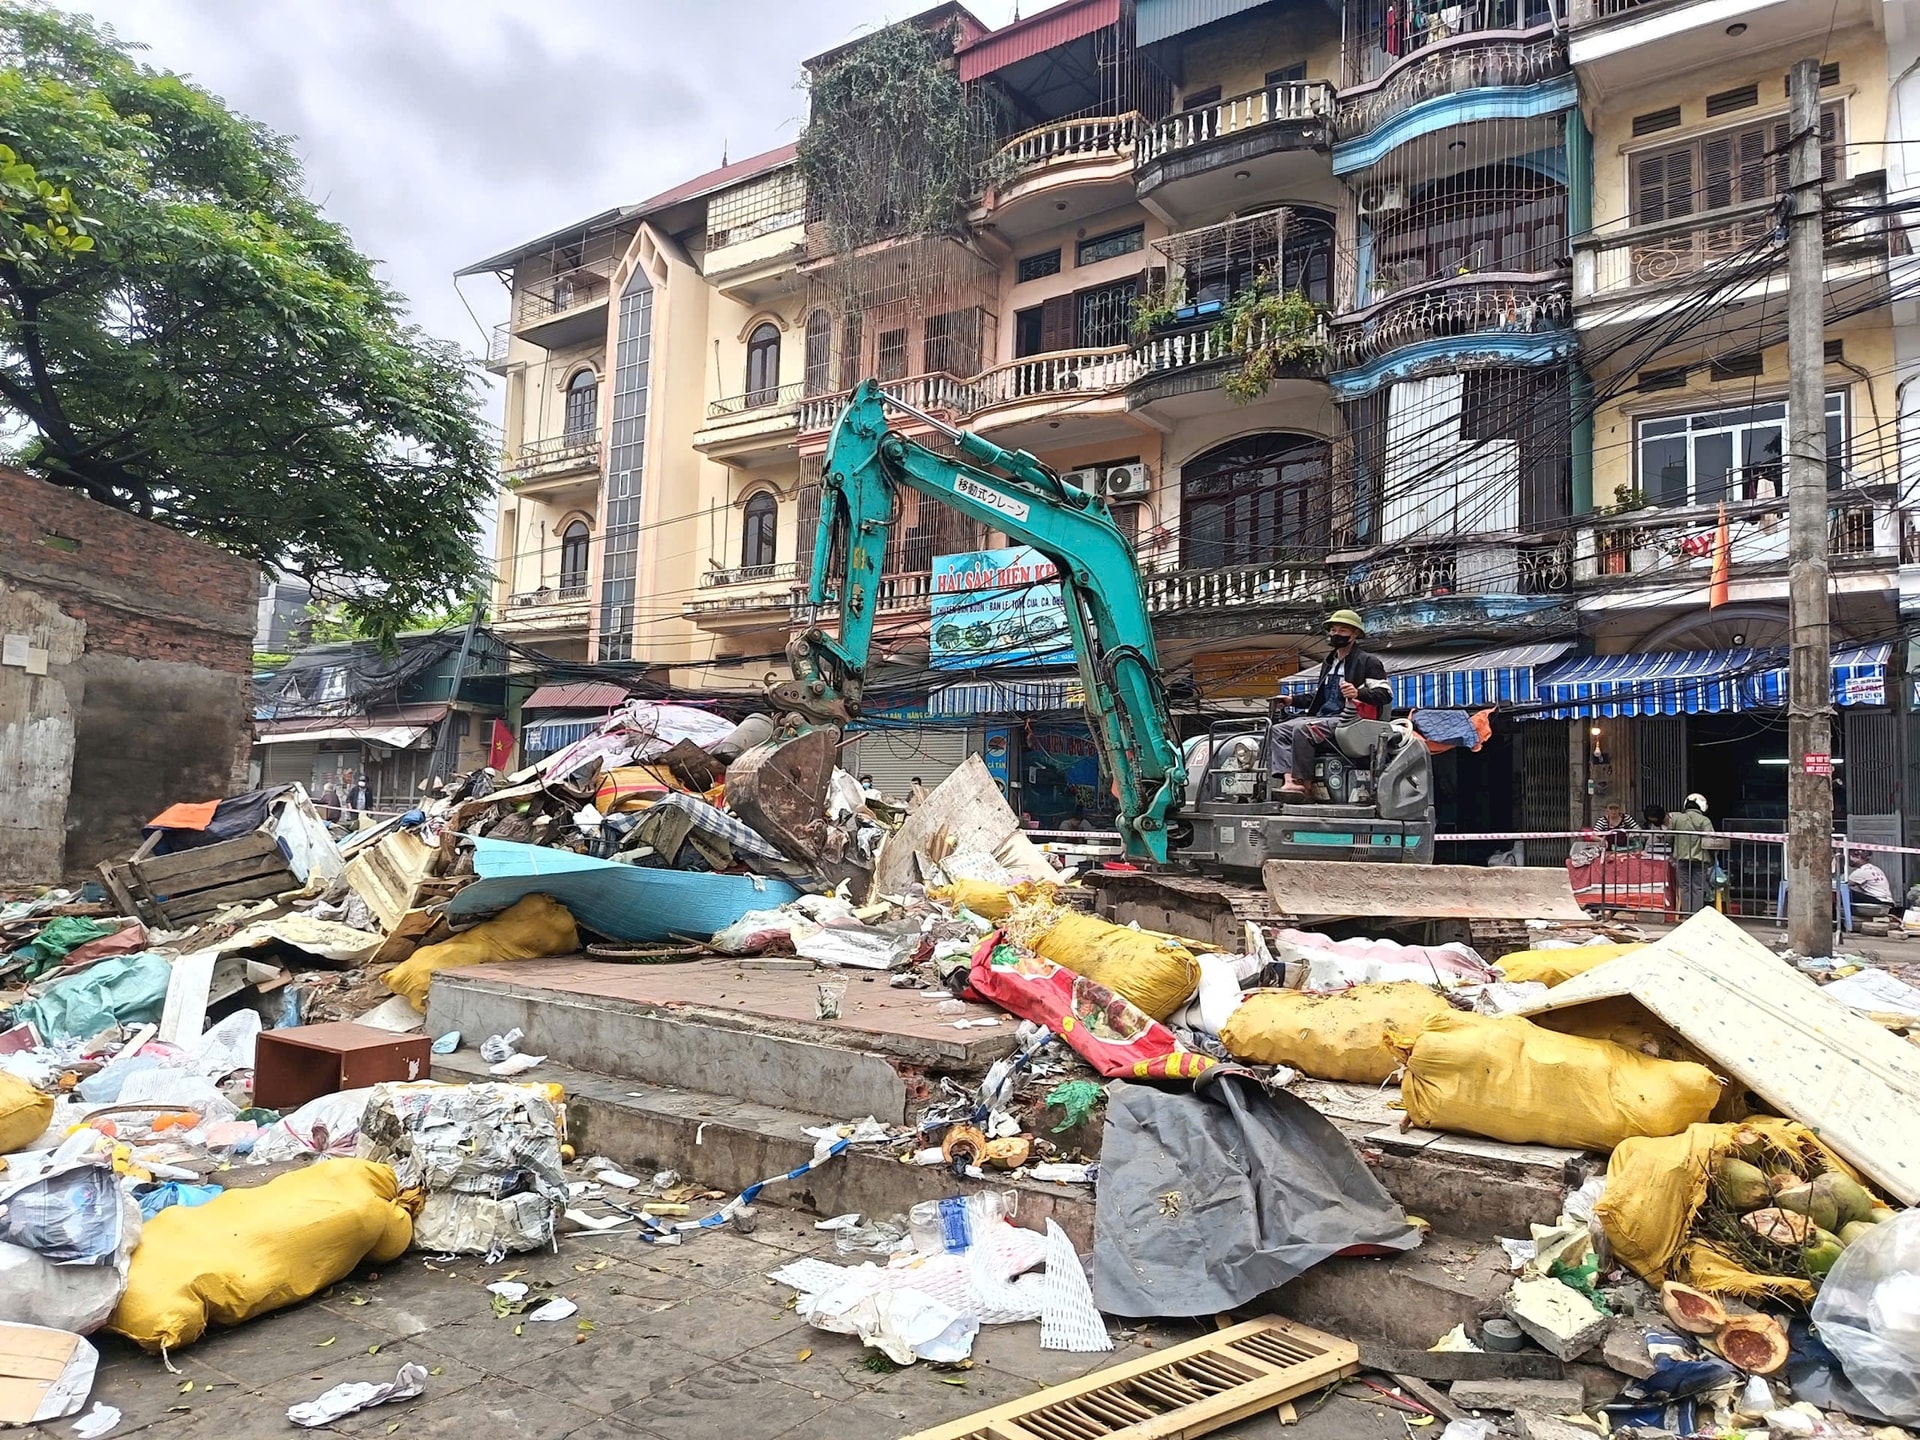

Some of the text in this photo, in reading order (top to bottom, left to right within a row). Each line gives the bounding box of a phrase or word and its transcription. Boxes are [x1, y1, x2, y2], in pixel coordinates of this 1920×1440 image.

[958, 478, 1025, 516] 移動式クレーン
[937, 565, 962, 593] HẢI
[965, 561, 993, 590] SẢN
